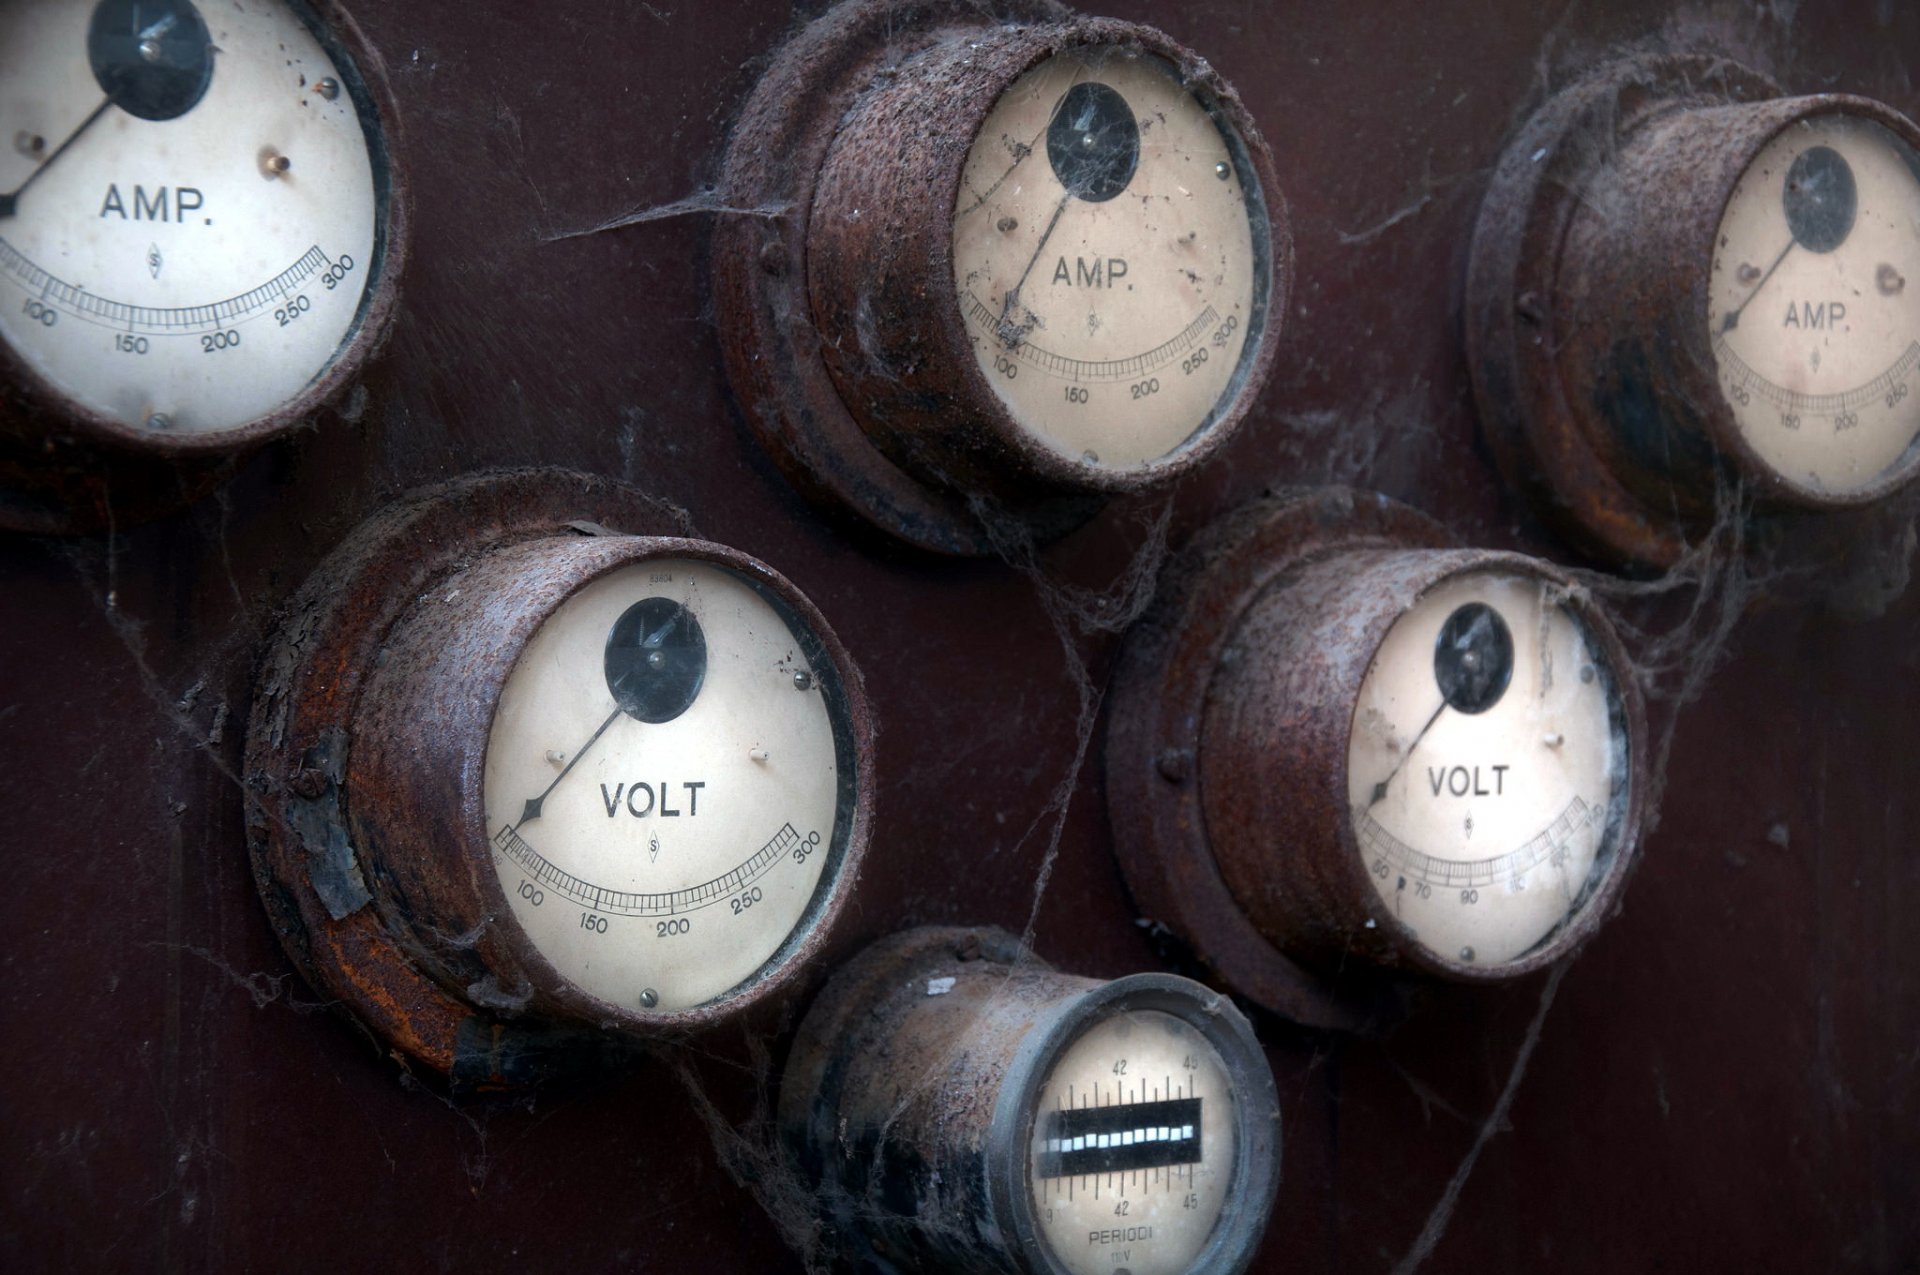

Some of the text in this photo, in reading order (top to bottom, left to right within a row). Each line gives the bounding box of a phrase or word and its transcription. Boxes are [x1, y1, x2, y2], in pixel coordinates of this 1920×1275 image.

[99, 182, 214, 227] AMP.
[1050, 255, 1135, 292] AMP.
[22, 253, 355, 355] 100 150 200 250 300
[1783, 300, 1851, 332] AMP.
[993, 315, 1239, 404] 100 150 200 250 300
[1834, 413, 1859, 431] 200
[1885, 383, 1909, 409] 250
[599, 780, 706, 818] VOLT
[1428, 764, 1511, 797] VOLT
[516, 878, 545, 907] 100
[580, 912, 609, 934] 150
[656, 917, 691, 938] 200
[730, 885, 763, 915] 250
[792, 829, 822, 866] 300
[1414, 881, 1432, 900] 70
[1112, 1059, 1128, 1076] 42
[1113, 1200, 1129, 1217] 42
[1183, 1194, 1198, 1210] 45
